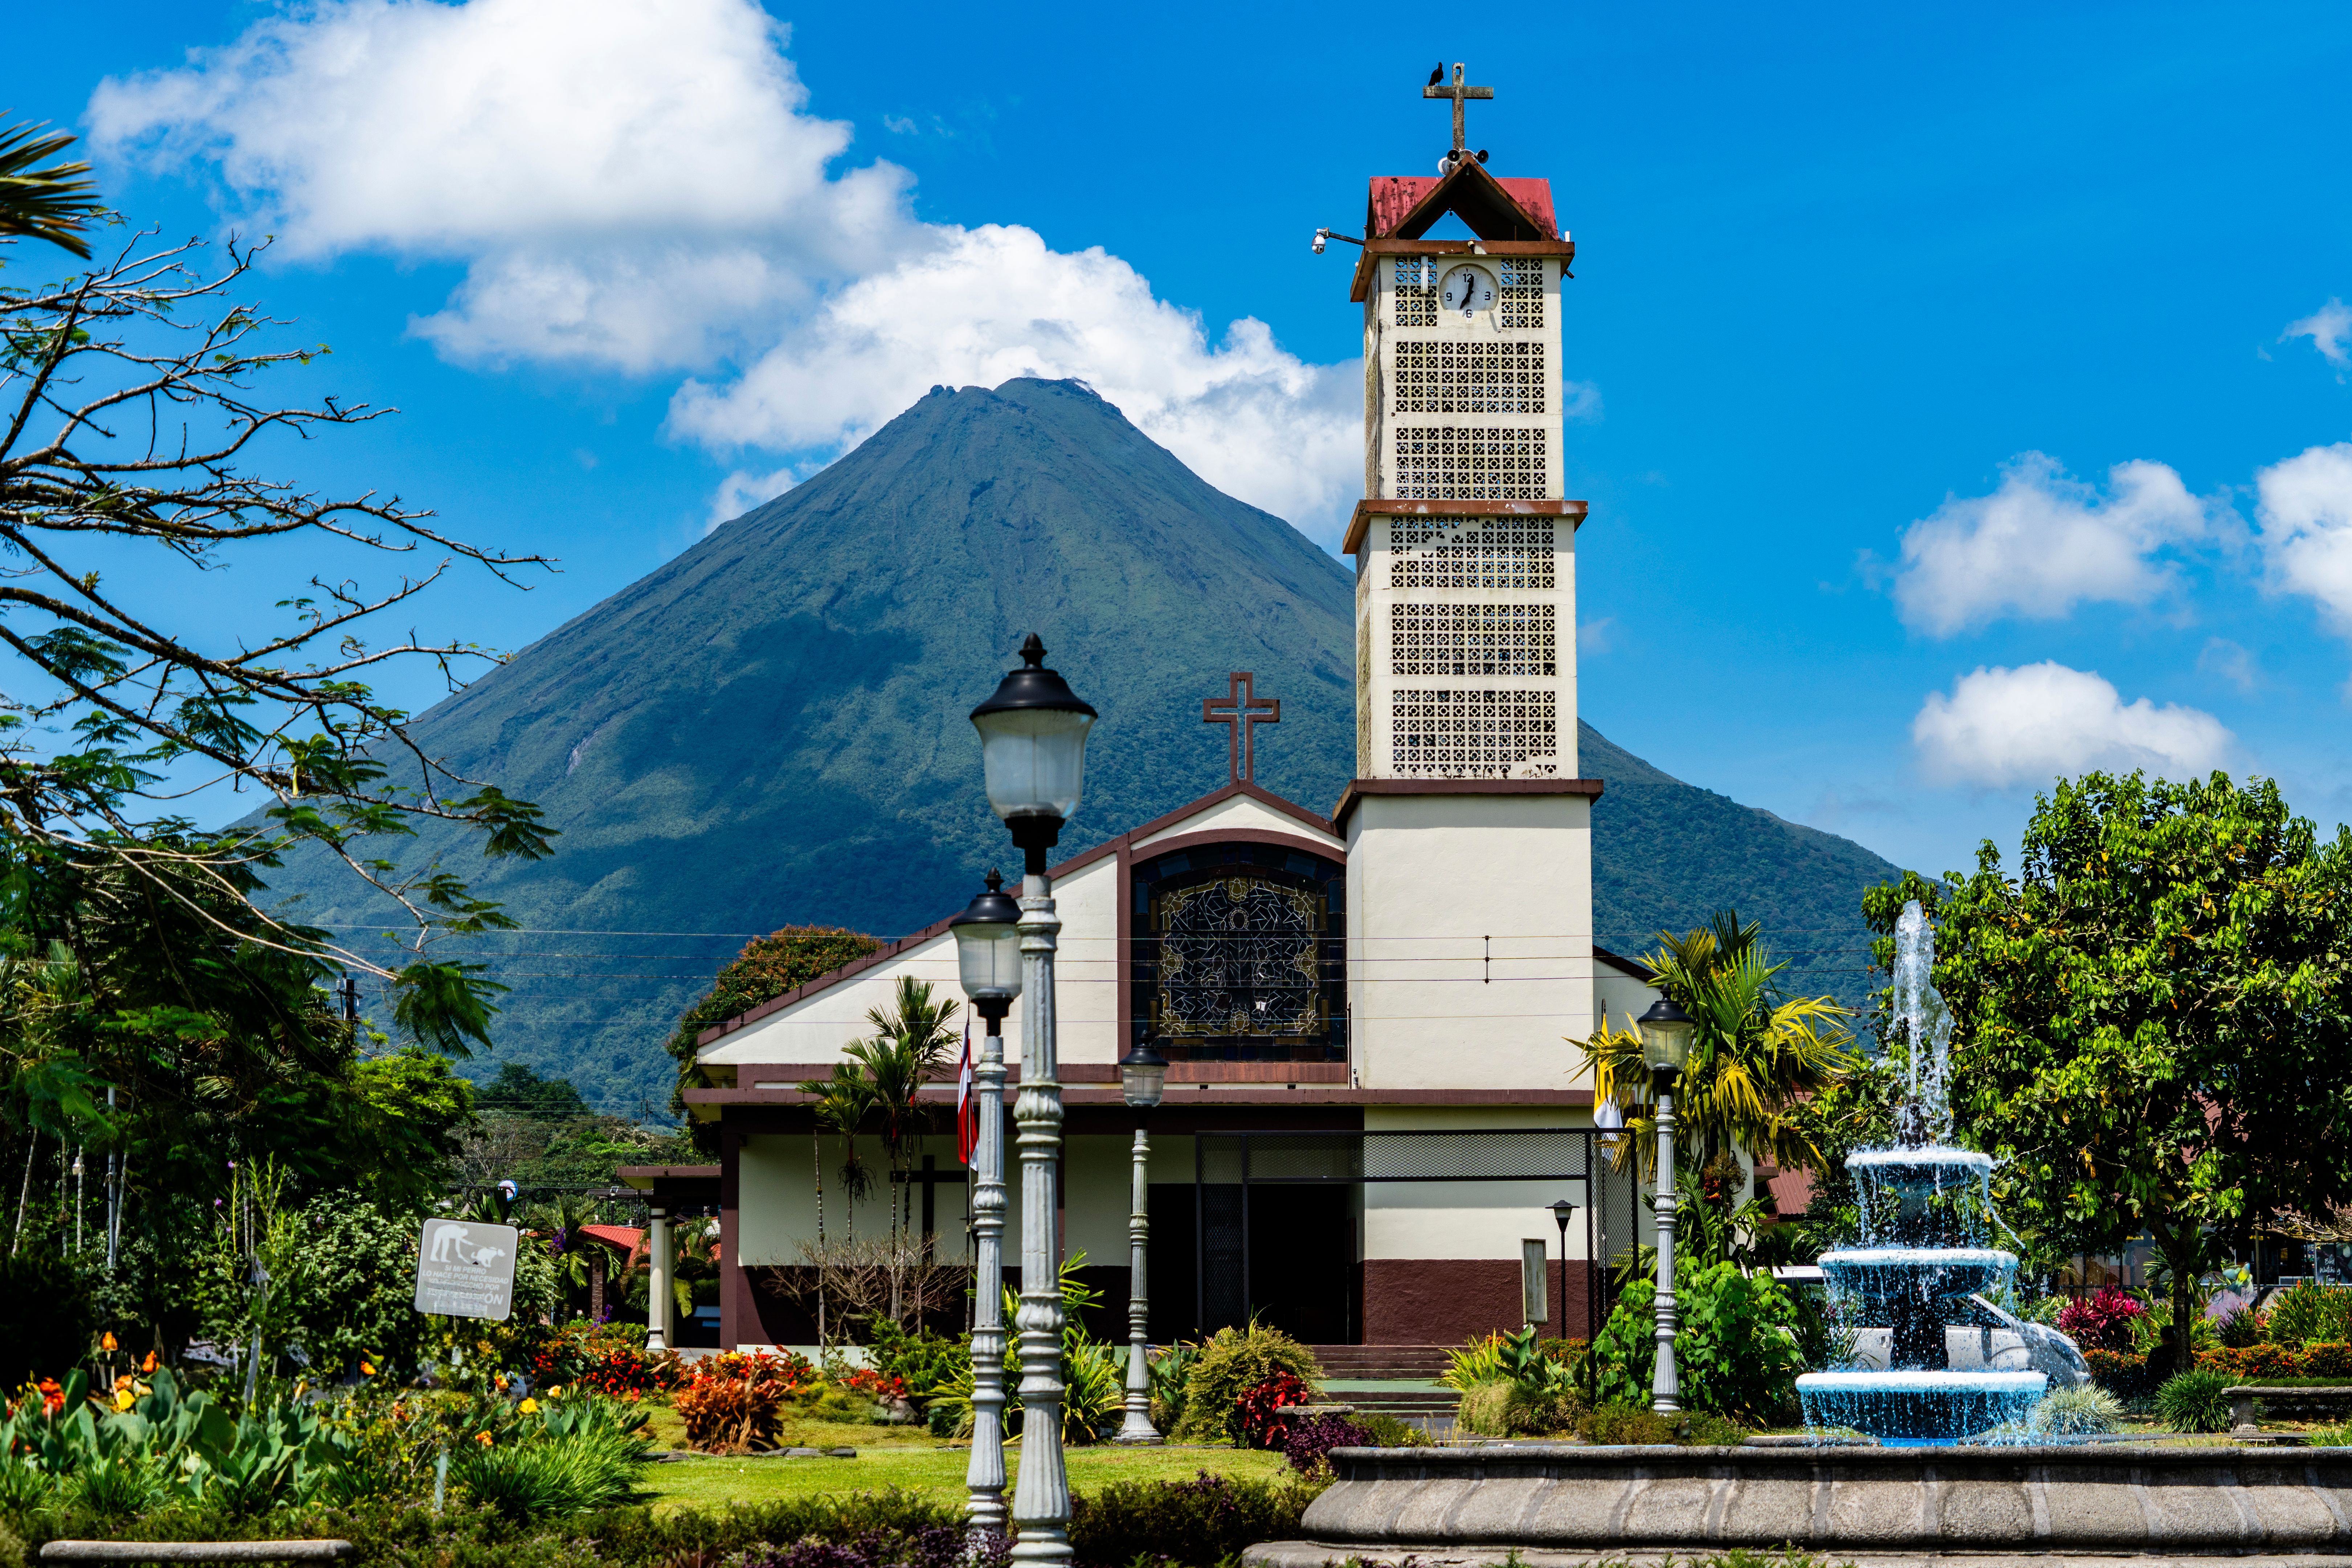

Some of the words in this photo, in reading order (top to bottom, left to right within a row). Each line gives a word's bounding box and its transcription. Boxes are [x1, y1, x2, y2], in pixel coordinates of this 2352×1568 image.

[1463, 273, 1473, 283] 12
[1446, 292, 1452, 301] 9
[1485, 291, 1491, 301] 3
[1466, 309, 1472, 318] 6
[2320, 1265, 2340, 1275] Watchig
[469, 1275, 509, 1284] NECESIDAD
